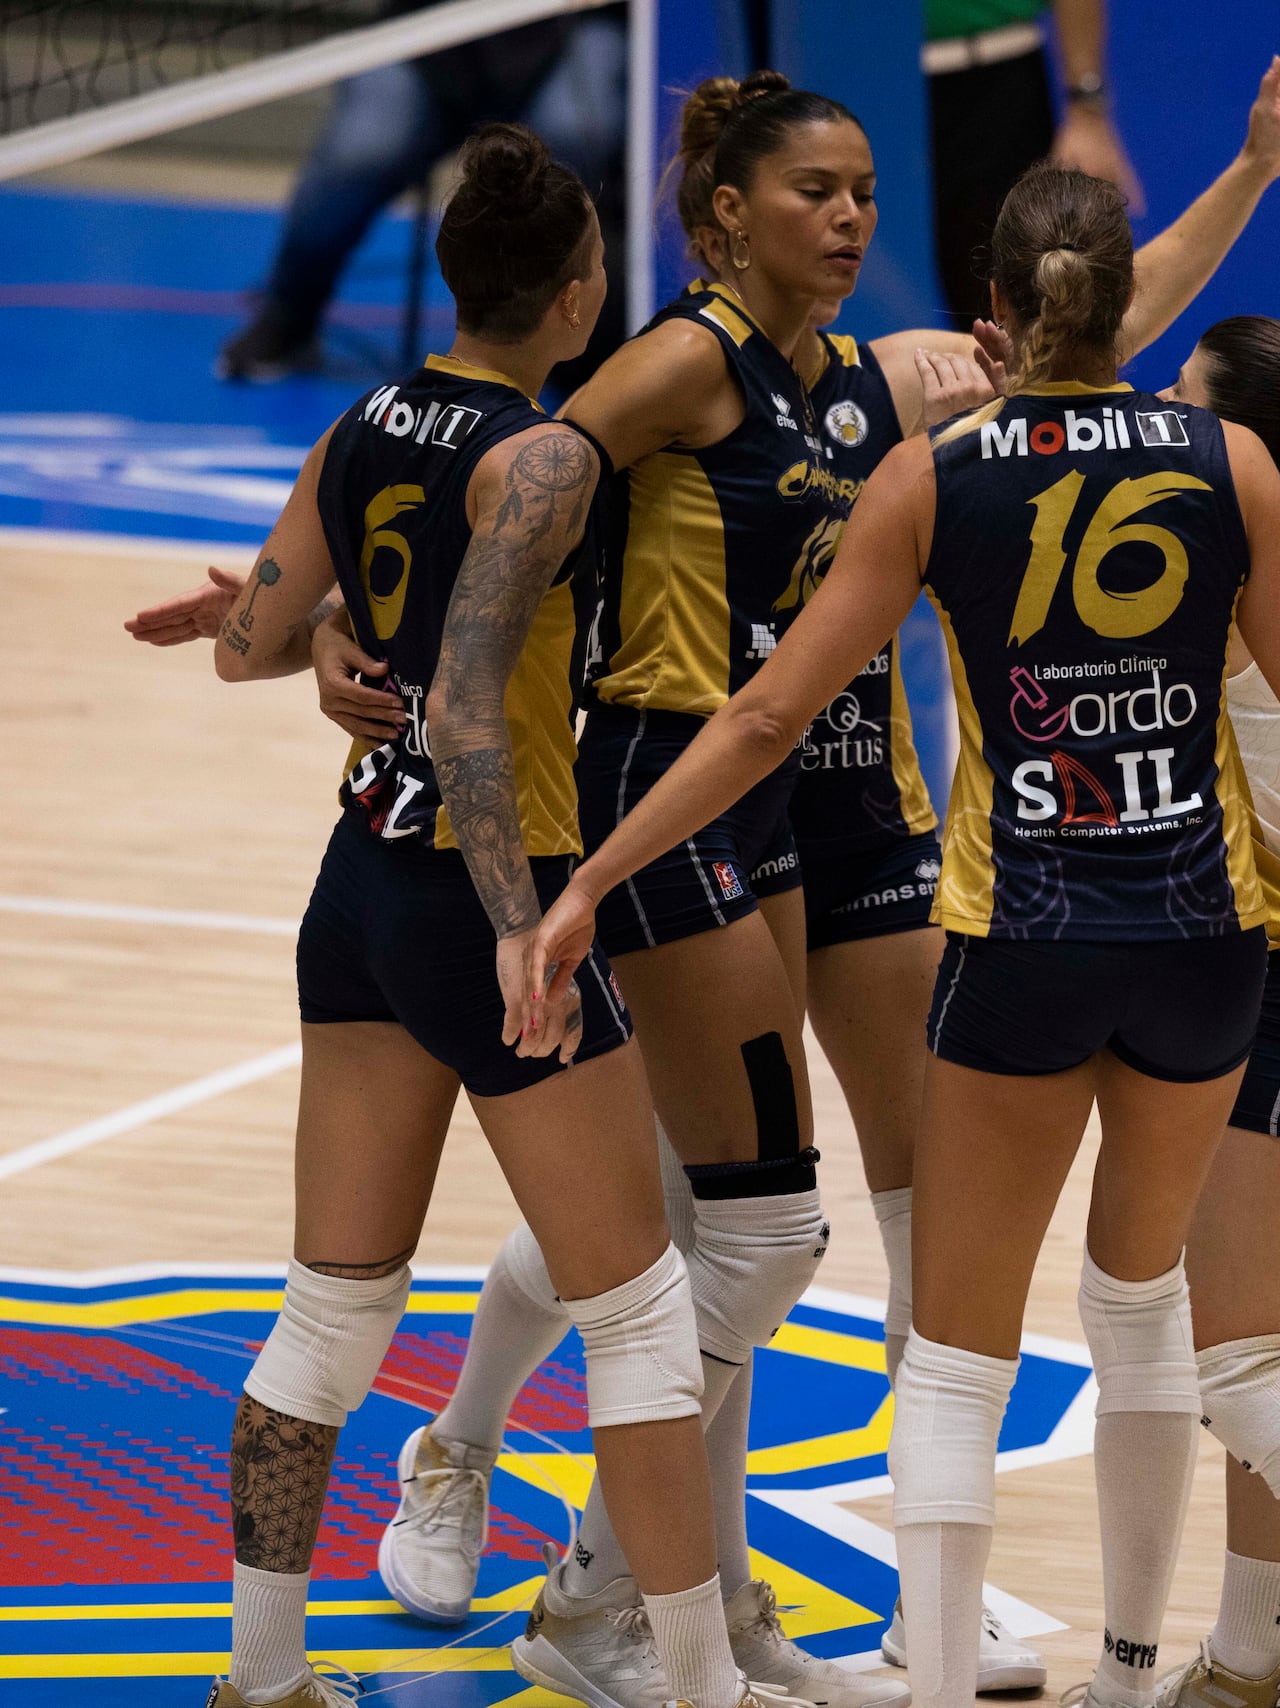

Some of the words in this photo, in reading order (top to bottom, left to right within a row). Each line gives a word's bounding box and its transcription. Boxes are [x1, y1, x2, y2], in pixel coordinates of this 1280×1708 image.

[979, 407, 1132, 460] Mobil
[359, 483, 426, 641] 6
[1006, 467, 1215, 649] 16
[1034, 660, 1117, 681] Laboratorio
[1119, 653, 1168, 675] Clínico
[1014, 826, 1056, 839] Health
[1060, 825, 1123, 839] Computer
